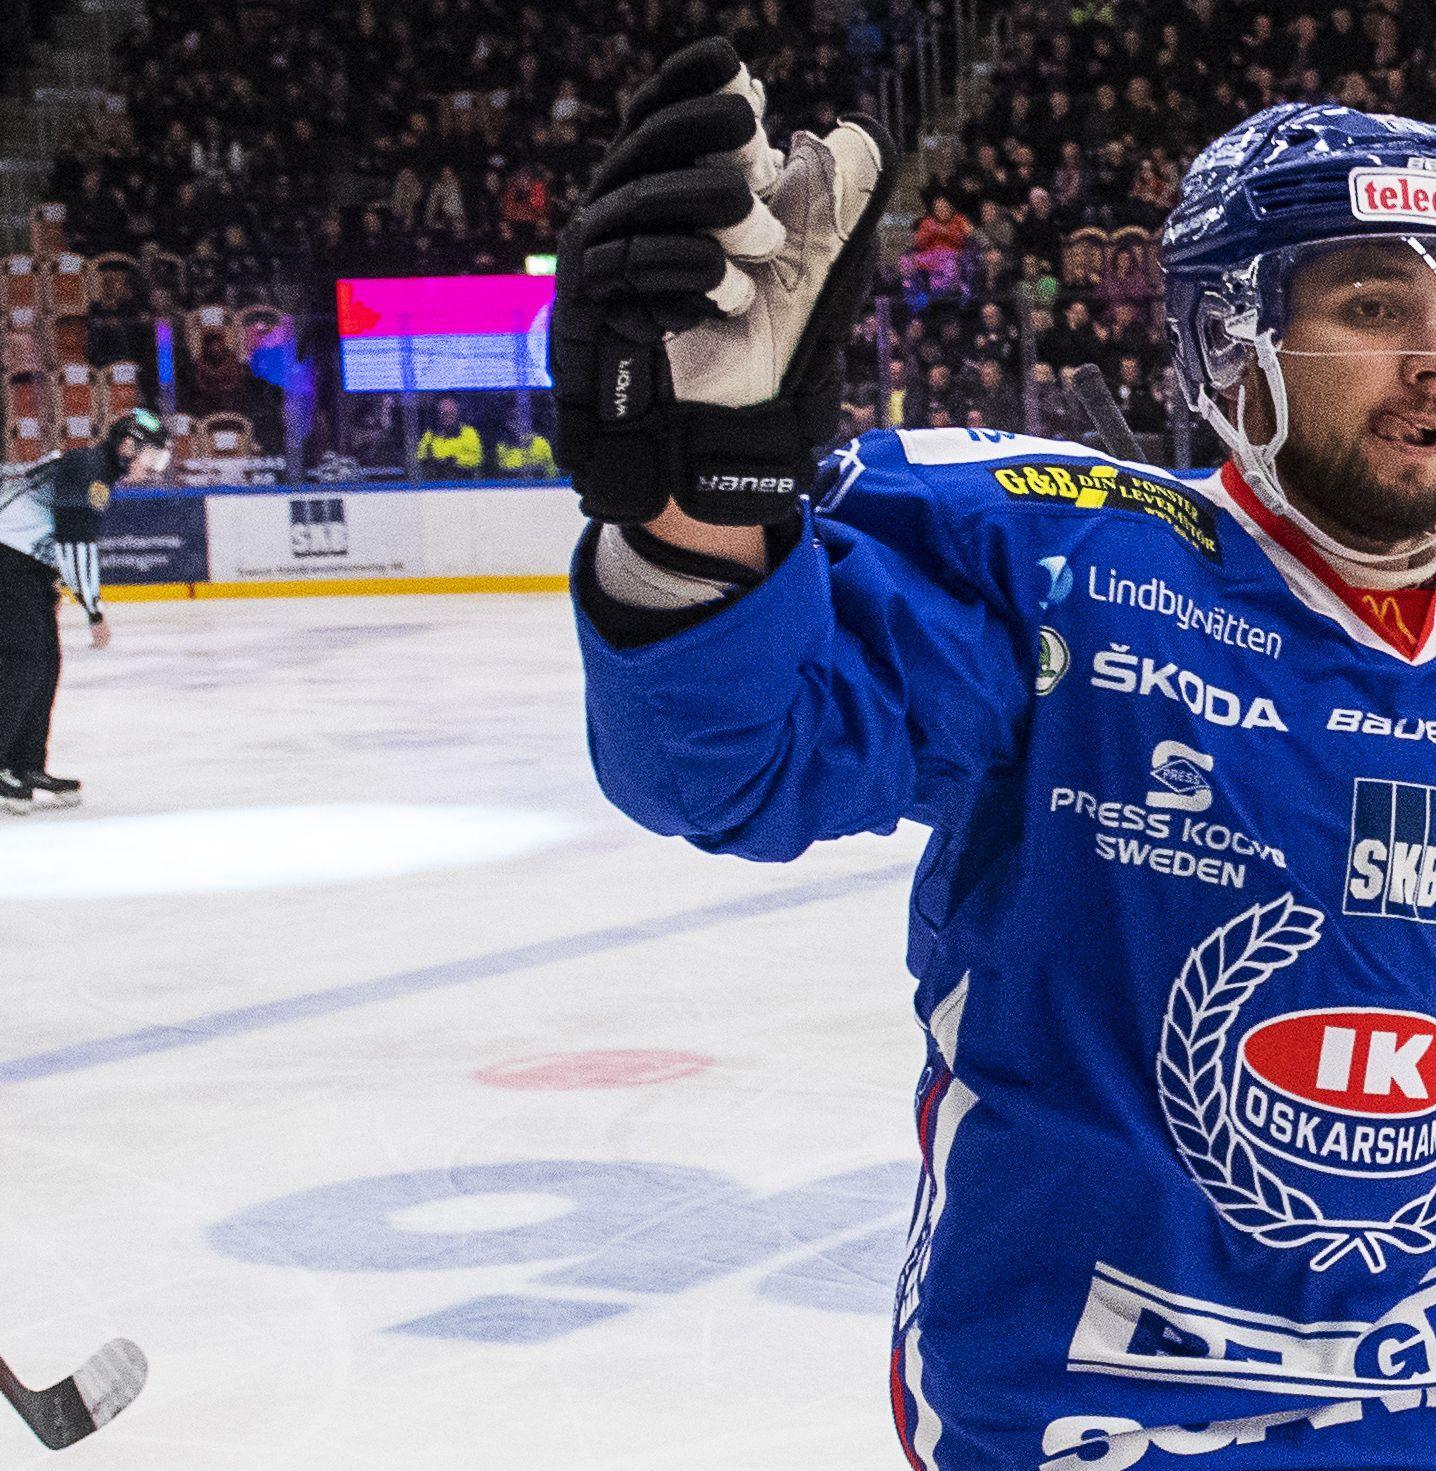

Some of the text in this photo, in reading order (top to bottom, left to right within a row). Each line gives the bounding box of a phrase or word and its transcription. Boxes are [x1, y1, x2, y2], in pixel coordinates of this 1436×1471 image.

[993, 466, 1076, 499] G&B
[1090, 643, 1290, 733] ŠKODA
[1050, 787, 1173, 839] PRESS
[1095, 833, 1246, 889] SWEDEN
[1315, 1025, 1435, 1100] IK
